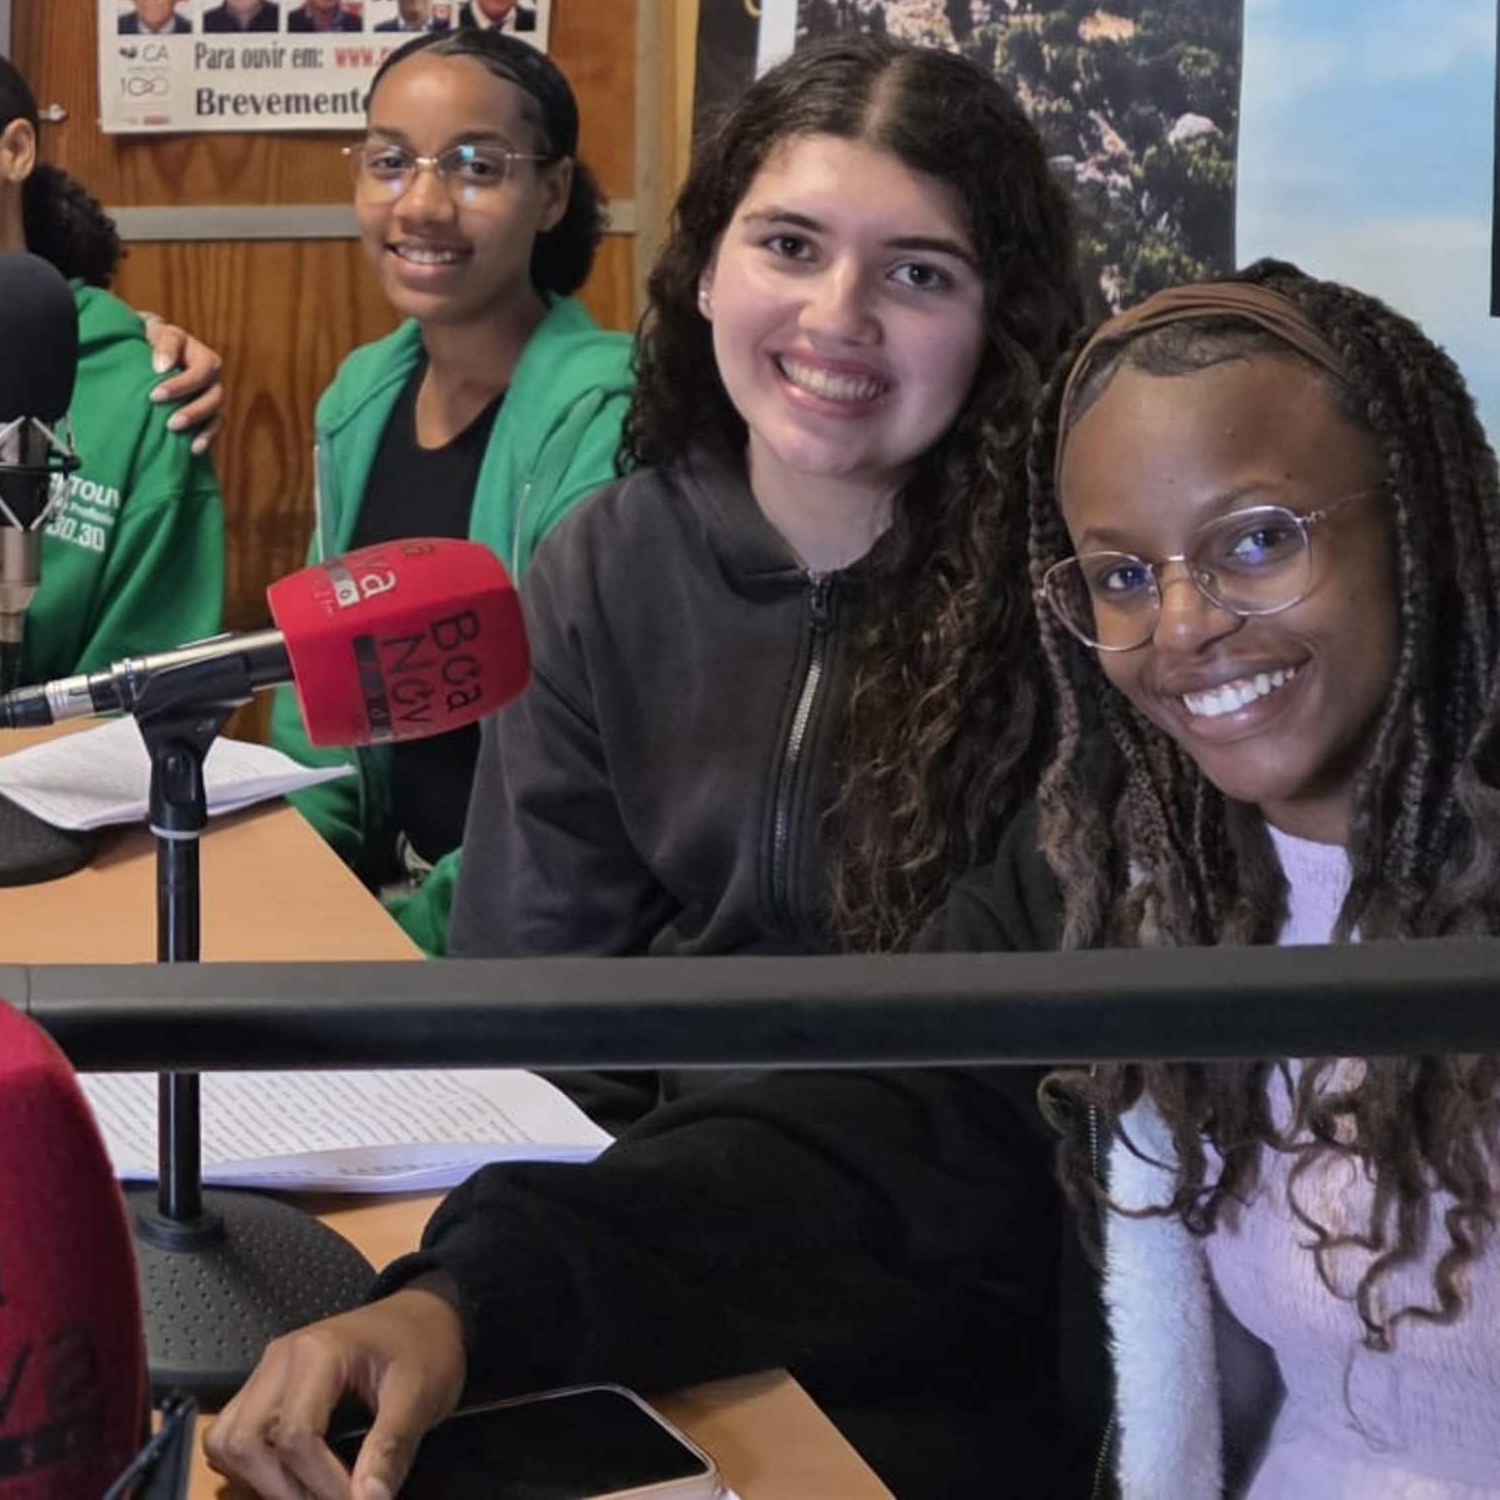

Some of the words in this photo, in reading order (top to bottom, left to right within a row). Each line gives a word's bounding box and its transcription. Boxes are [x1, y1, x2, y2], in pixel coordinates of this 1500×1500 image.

[195, 43, 235, 69] Para
[242, 40, 285, 69] ouvir
[292, 46, 323, 69] em:
[381, 632, 436, 730] Nov
[431, 611, 482, 712] Boa
